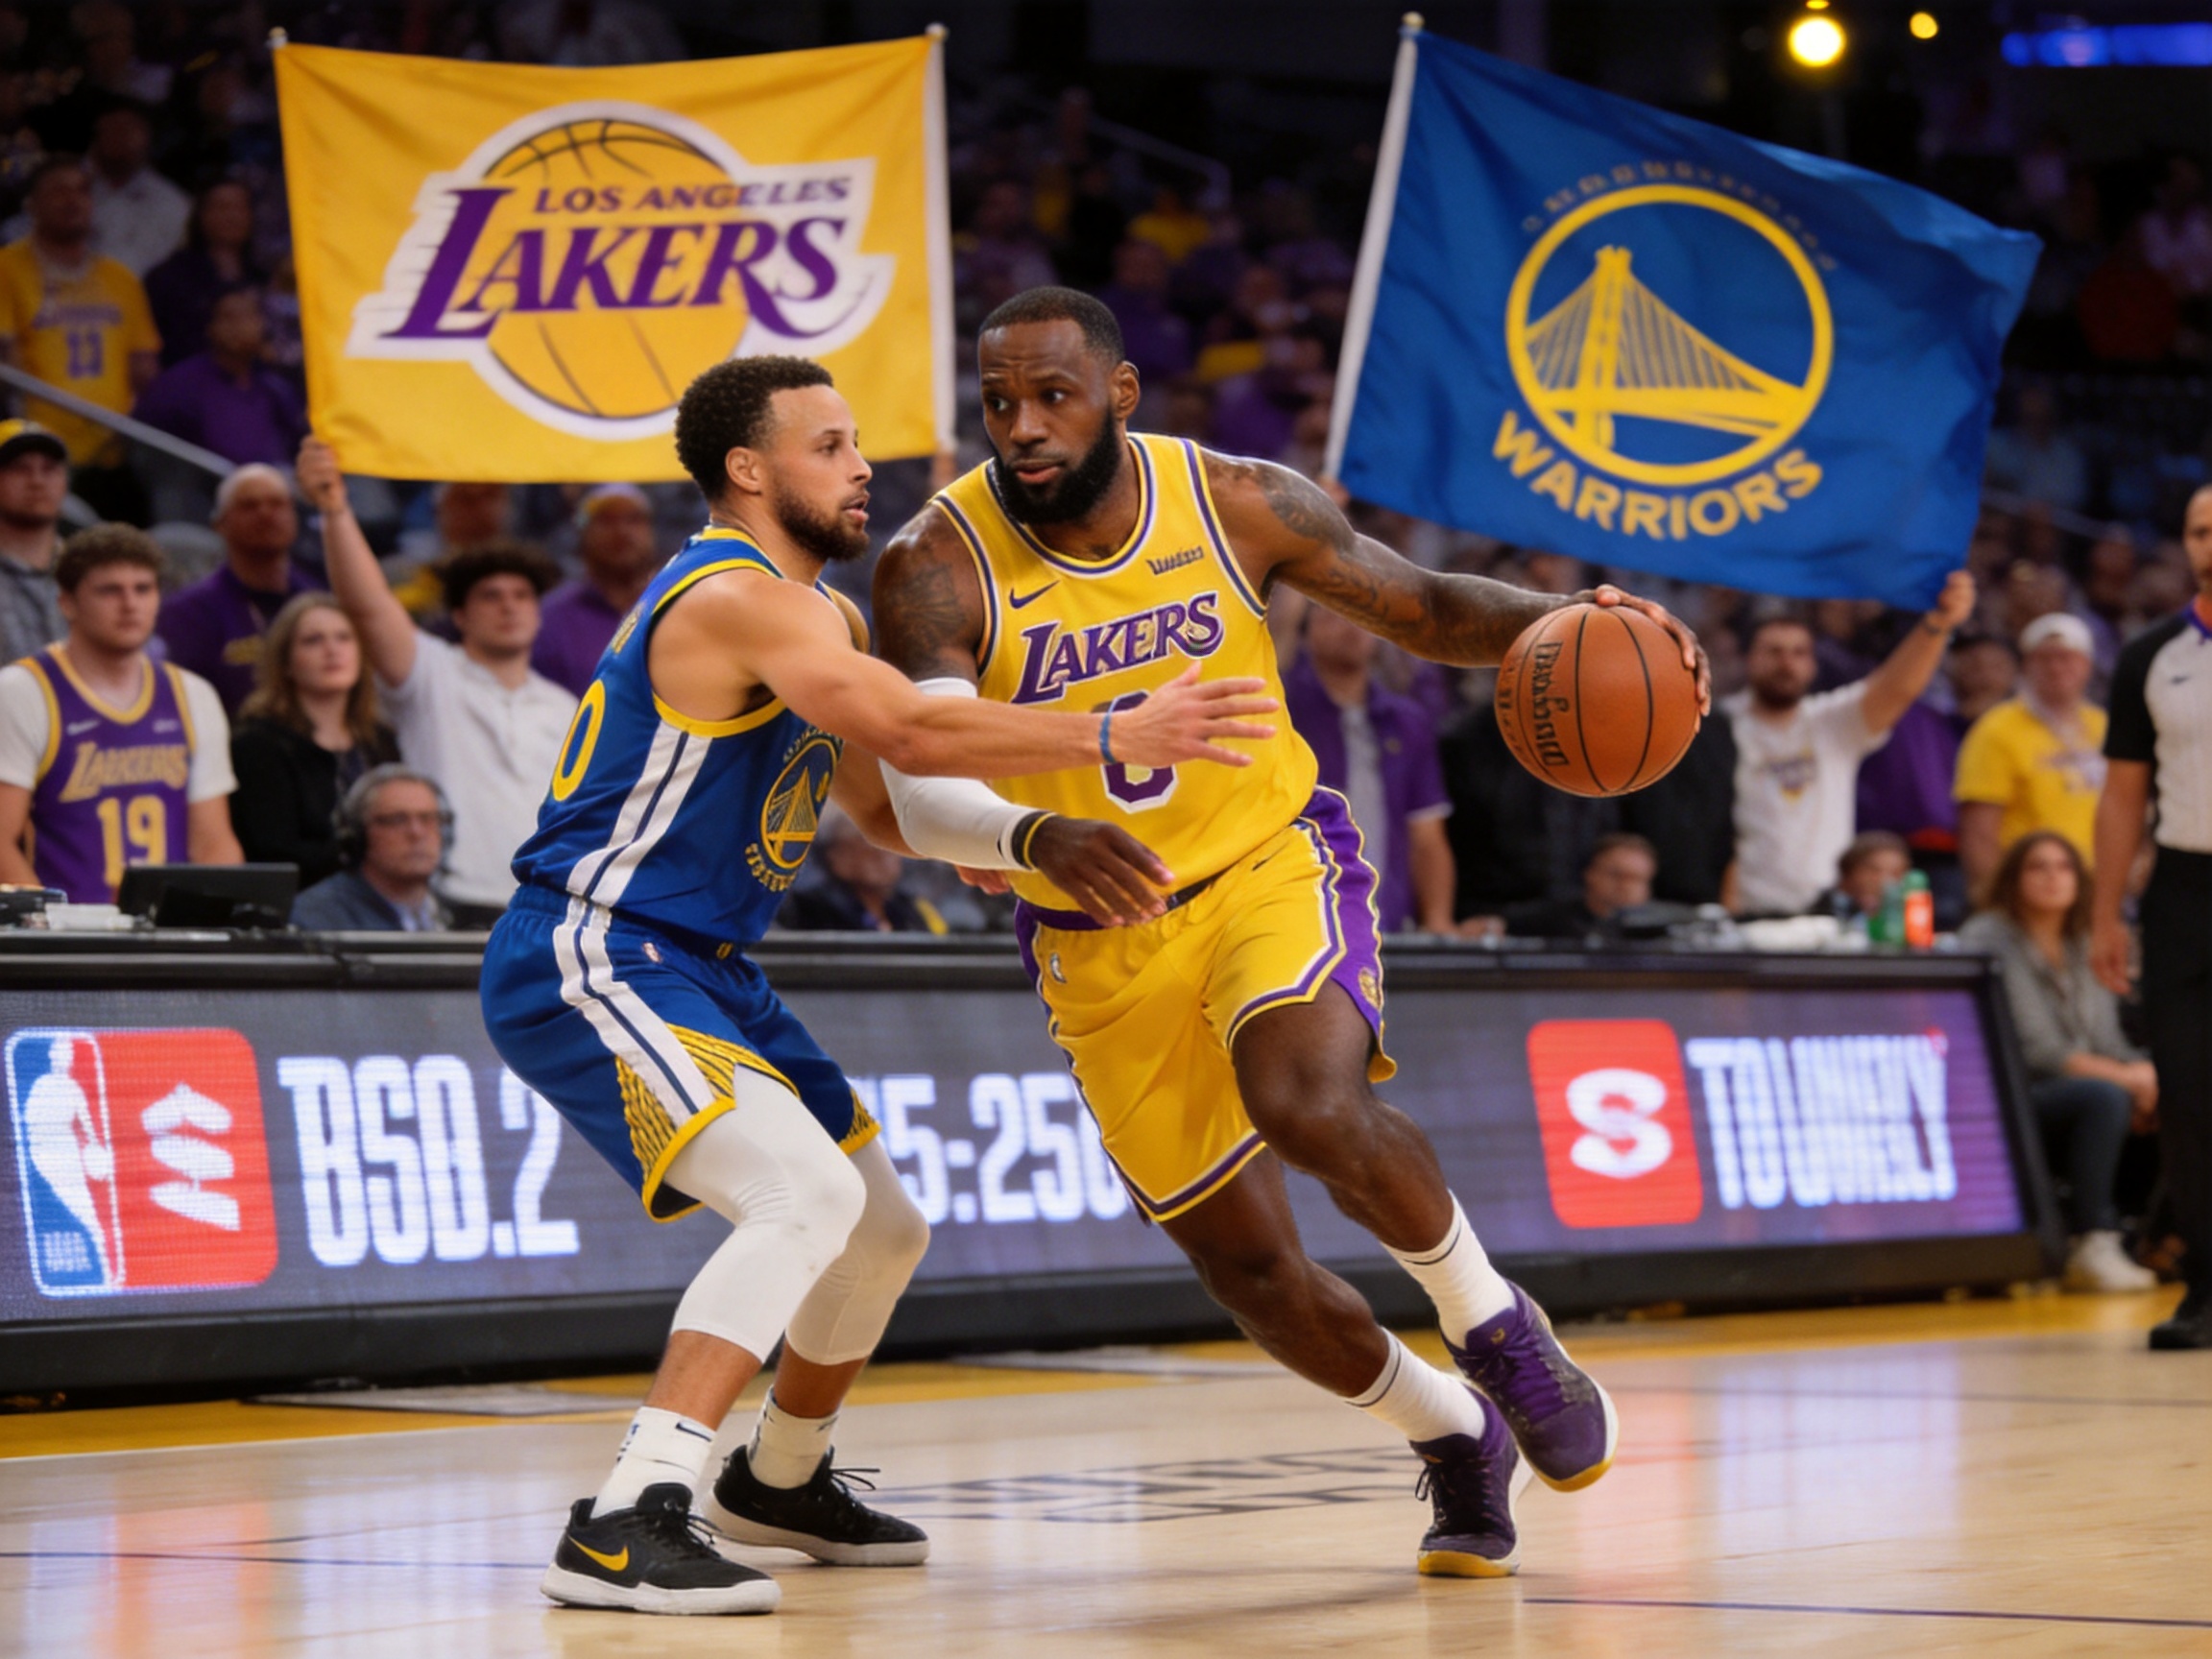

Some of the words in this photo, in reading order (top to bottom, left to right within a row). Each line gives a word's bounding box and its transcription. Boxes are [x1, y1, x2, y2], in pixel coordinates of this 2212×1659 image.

[534, 186, 620, 214] LOS
[637, 176, 852, 210] ANGELES
[377, 188, 873, 340] LAKERS
[1492, 410, 1822, 541] WARRIORS
[1011, 590, 1224, 705] LAKERS
[97, 794, 167, 887] 19
